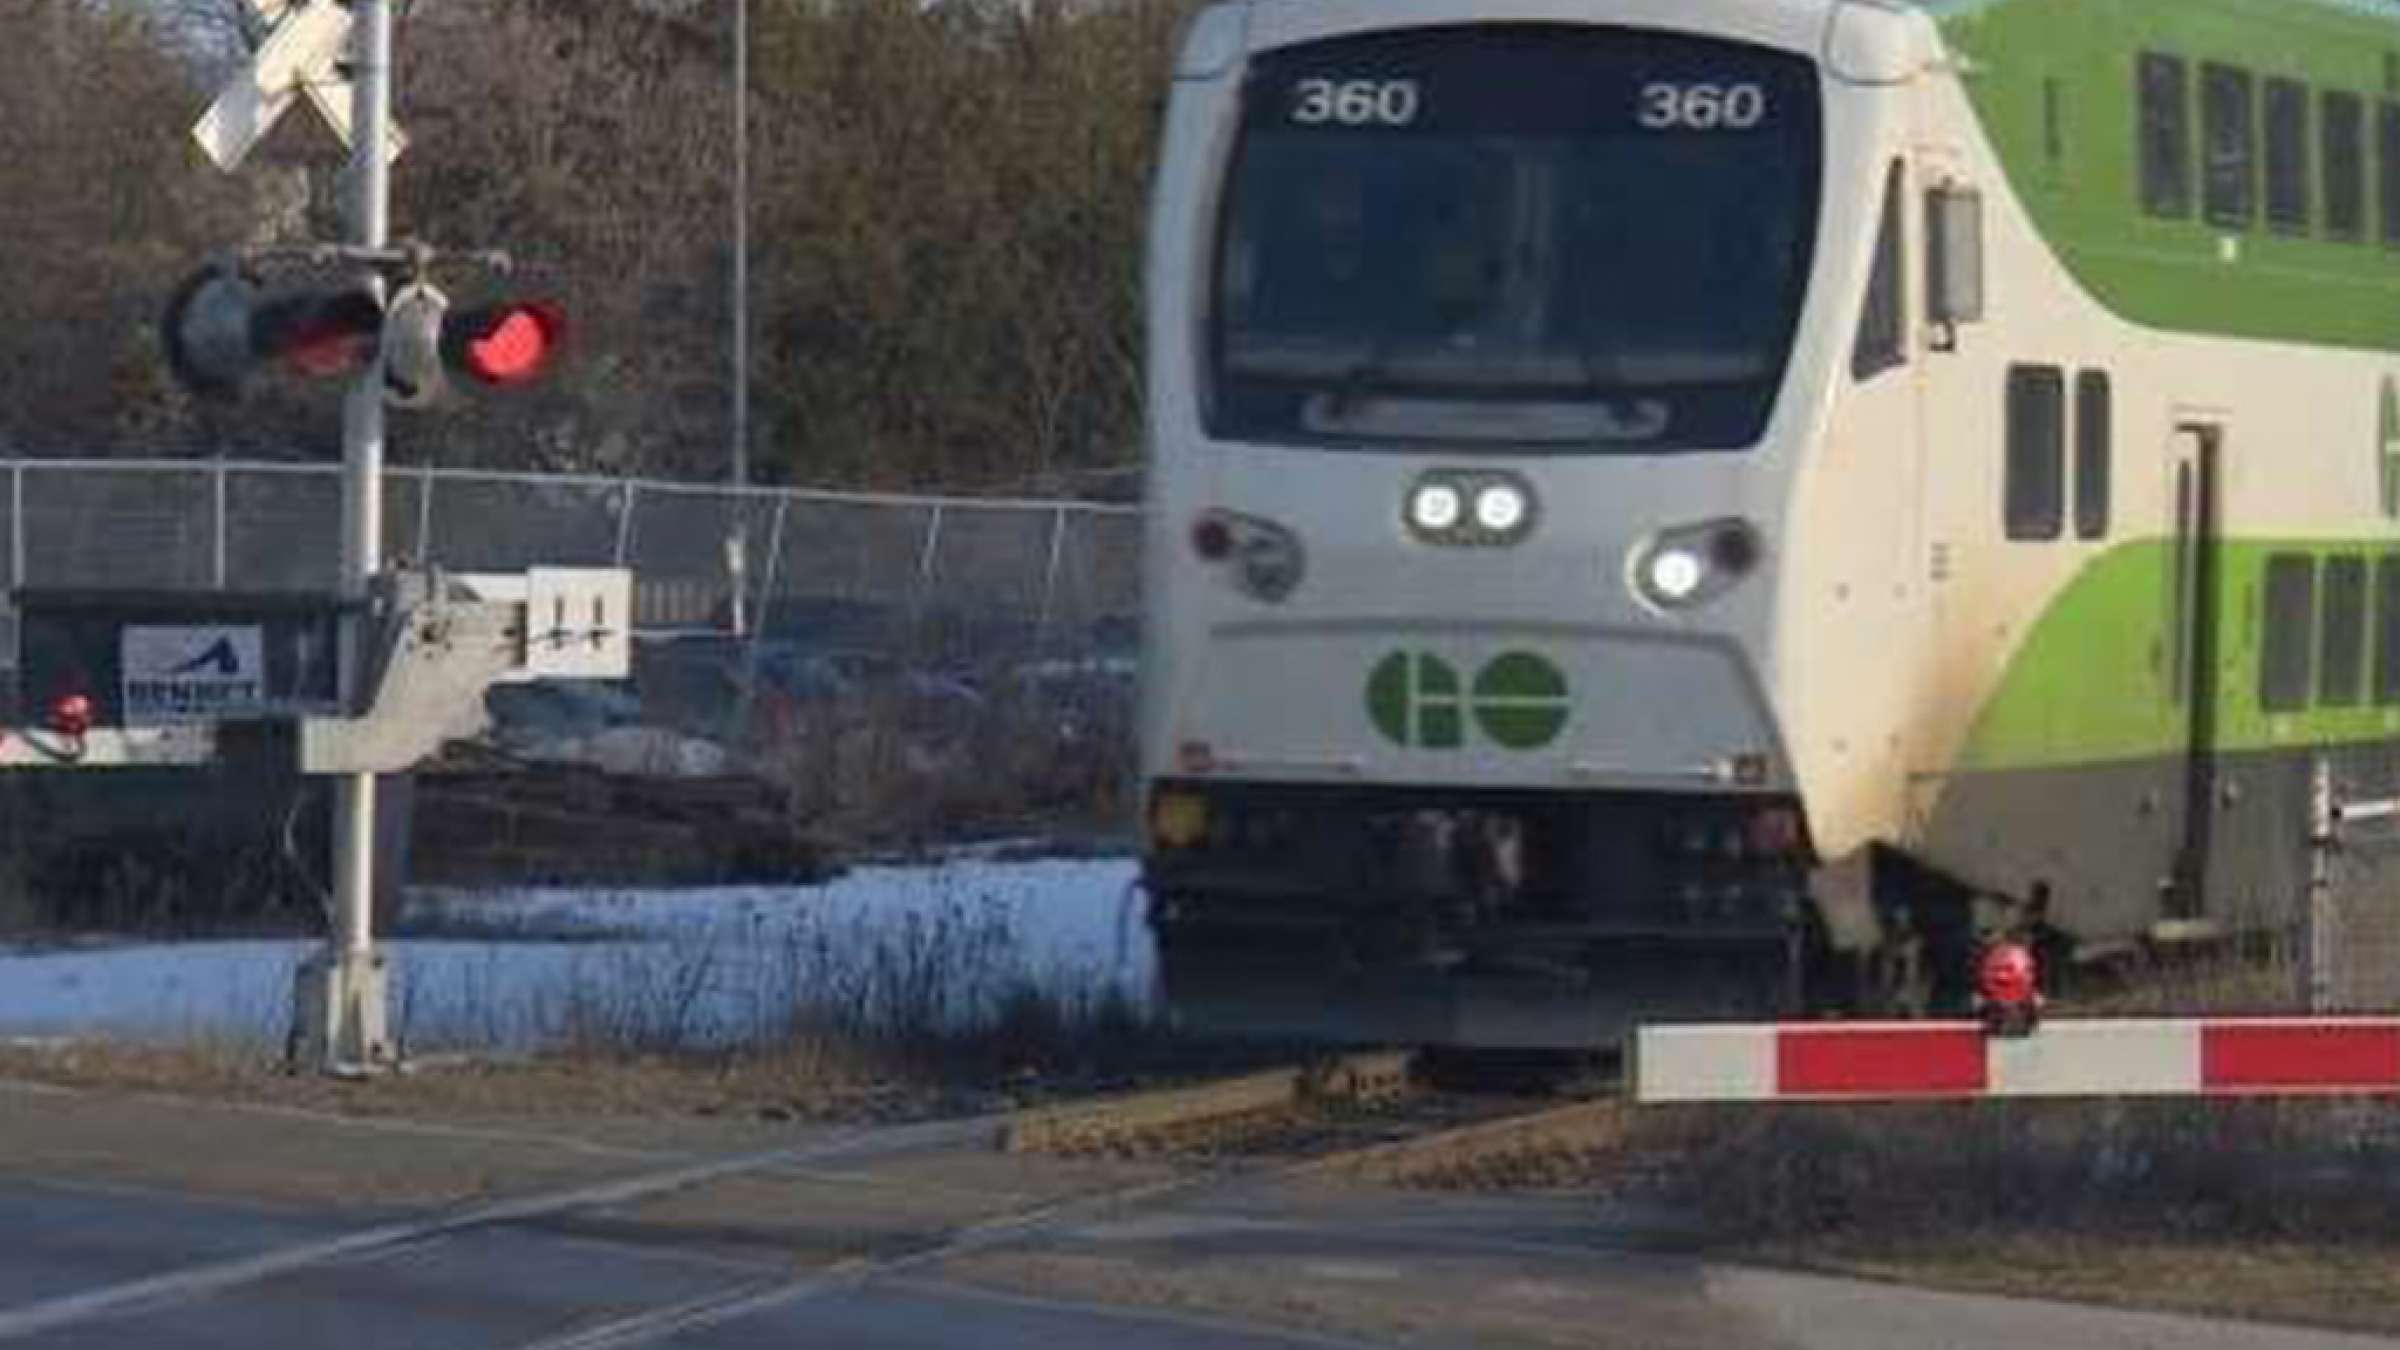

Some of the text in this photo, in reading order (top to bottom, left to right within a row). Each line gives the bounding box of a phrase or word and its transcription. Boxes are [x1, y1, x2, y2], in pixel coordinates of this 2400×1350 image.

[1293, 80, 1417, 124] 360
[1639, 83, 1764, 128] 360
[1365, 649, 1570, 749] GO
